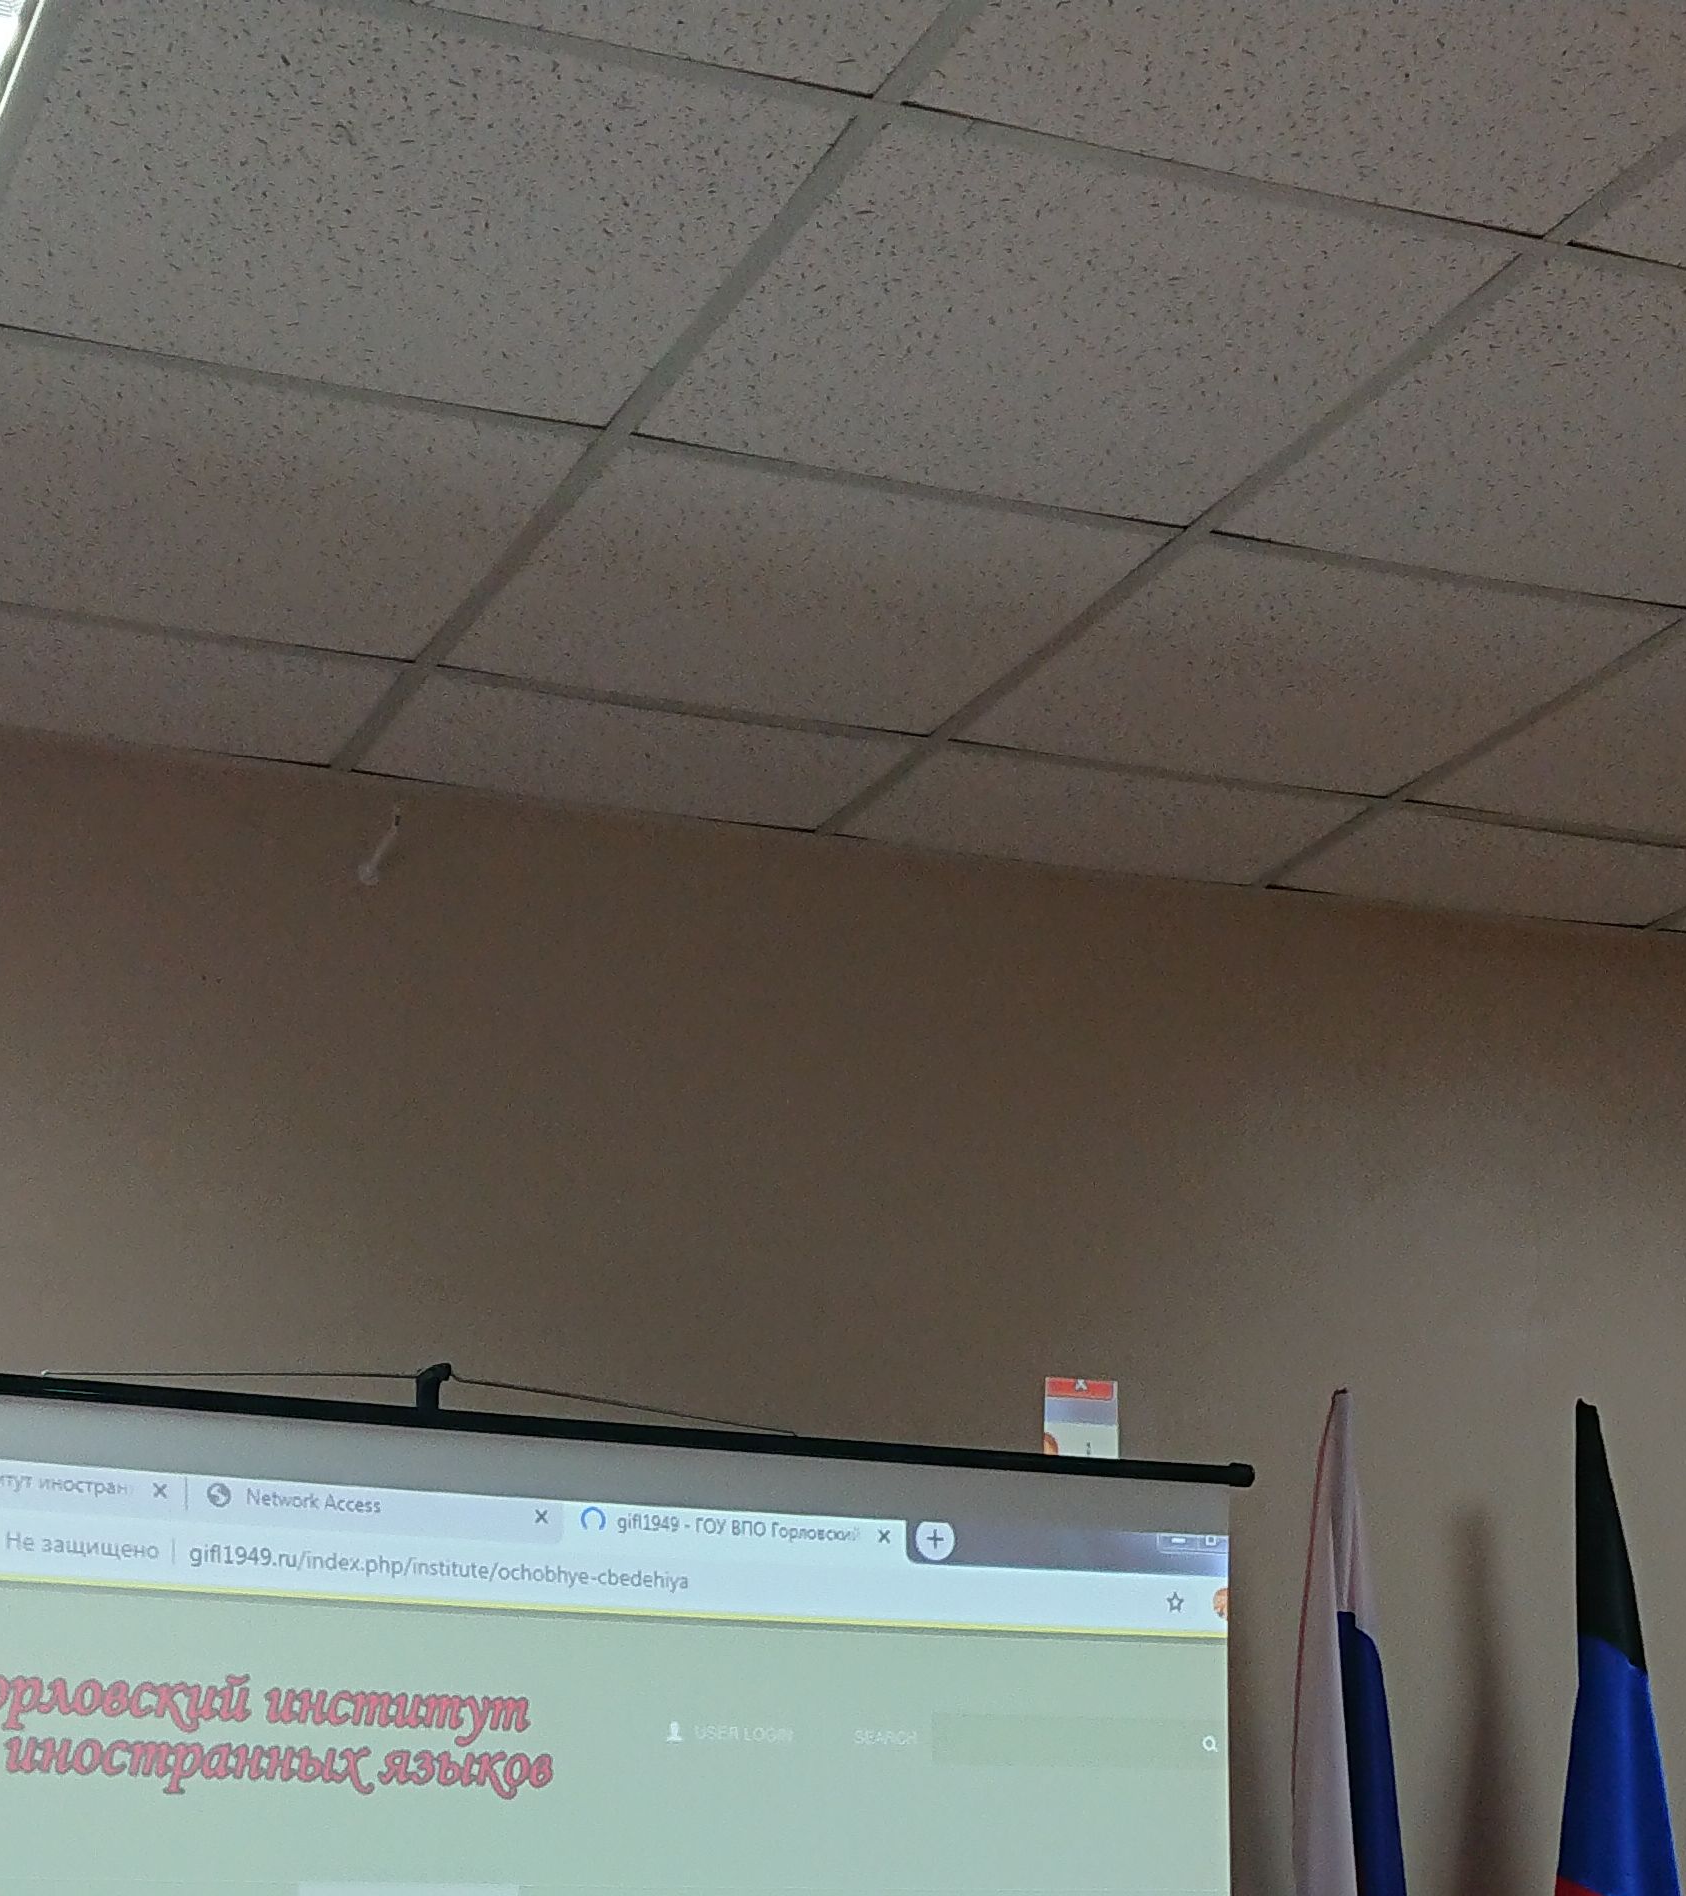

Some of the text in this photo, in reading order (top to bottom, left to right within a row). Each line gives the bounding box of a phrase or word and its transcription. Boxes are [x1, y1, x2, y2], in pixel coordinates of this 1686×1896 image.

[246, 1486, 381, 1515] Network Access
[695, 1516, 726, 1537] ГОУ
[732, 1519, 766, 1538] ВПО
[5, 1532, 159, 1561] Не защищено
[265, 1686, 530, 1746] институт
[5, 1733, 554, 1800] иностранных языков
